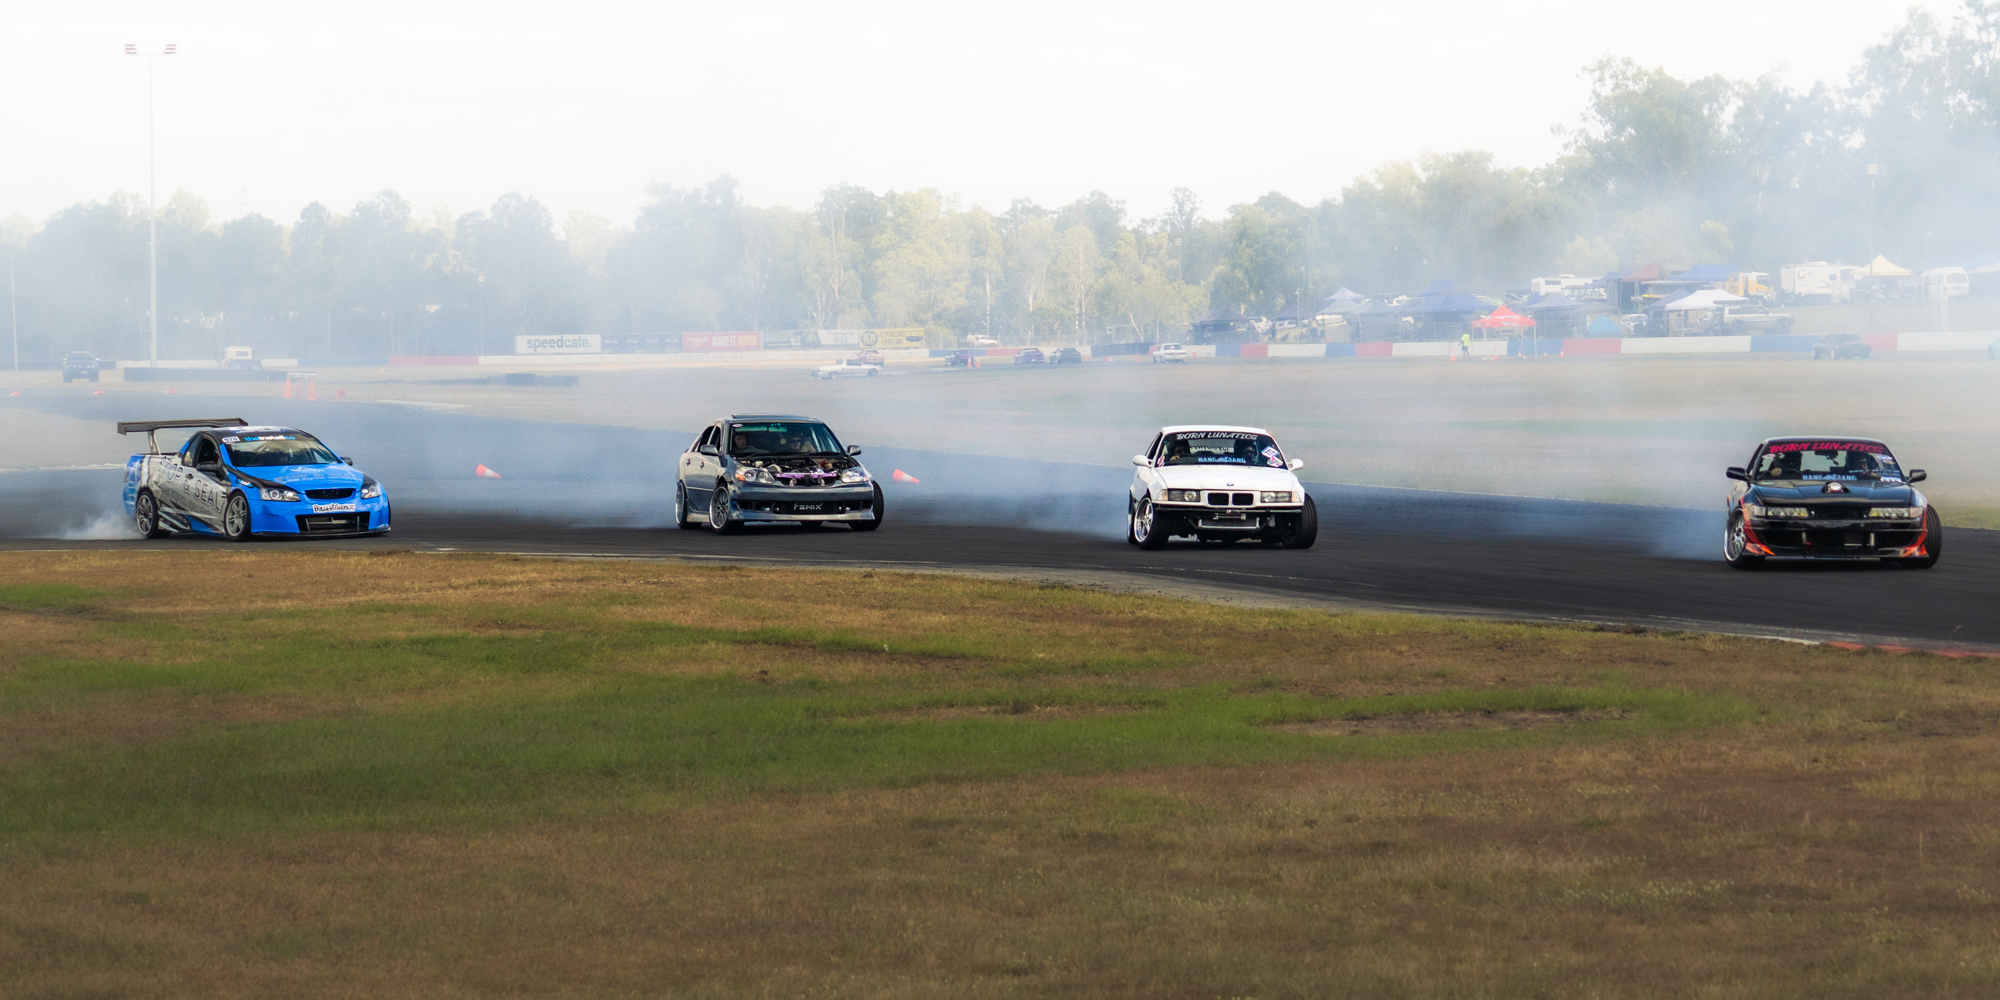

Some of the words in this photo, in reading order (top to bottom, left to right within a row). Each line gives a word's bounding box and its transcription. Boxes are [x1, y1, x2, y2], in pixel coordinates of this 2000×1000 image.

[712, 336, 729, 346] MAKE
[730, 336, 736, 346] IT
[737, 335, 757, 346] SUPER
[1176, 432, 1206, 440] BORN
[1207, 431, 1258, 440] LUNATICS
[1769, 443, 1810, 453] BORN
[1812, 442, 1884, 454] LUNATICS
[157, 457, 184, 481] STOP
[194, 478, 221, 512] SEAL
